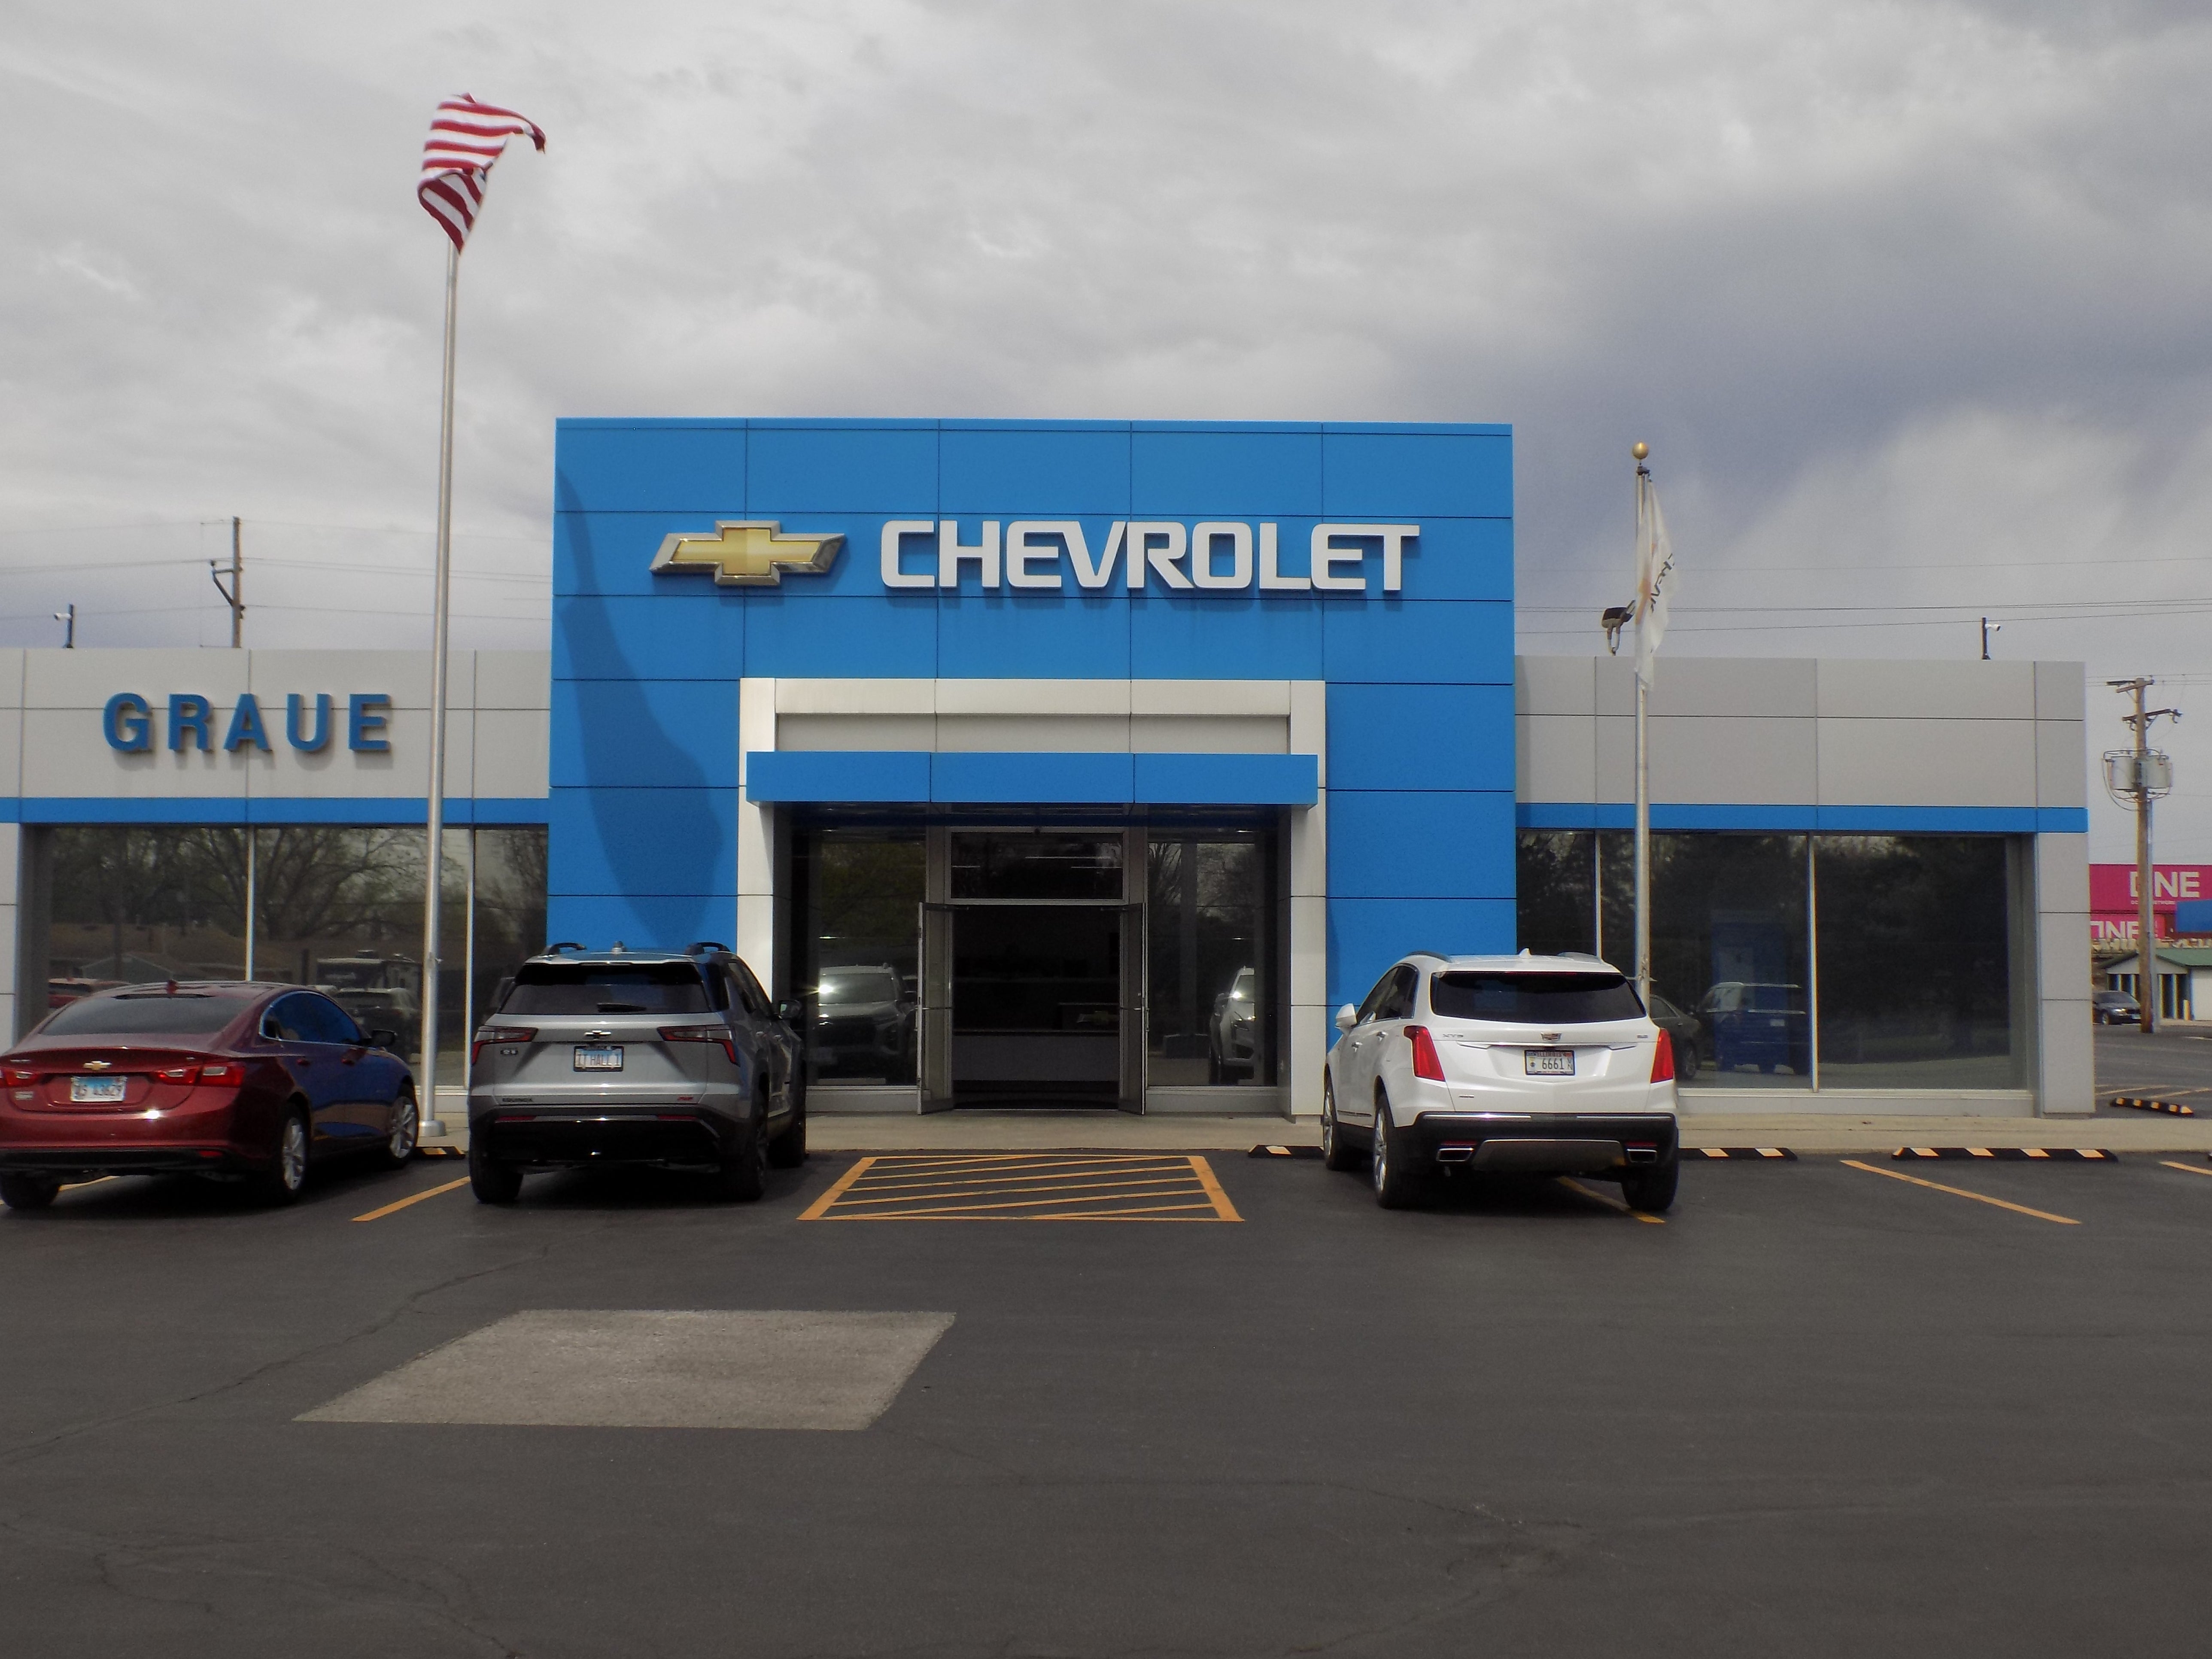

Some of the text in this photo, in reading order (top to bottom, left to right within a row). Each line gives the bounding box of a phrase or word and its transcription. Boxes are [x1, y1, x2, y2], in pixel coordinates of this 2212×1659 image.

[880, 520, 1420, 592] CHEVROLET
[102, 691, 392, 753] GRAUE
[1542, 1057, 1565, 1070] 6661
